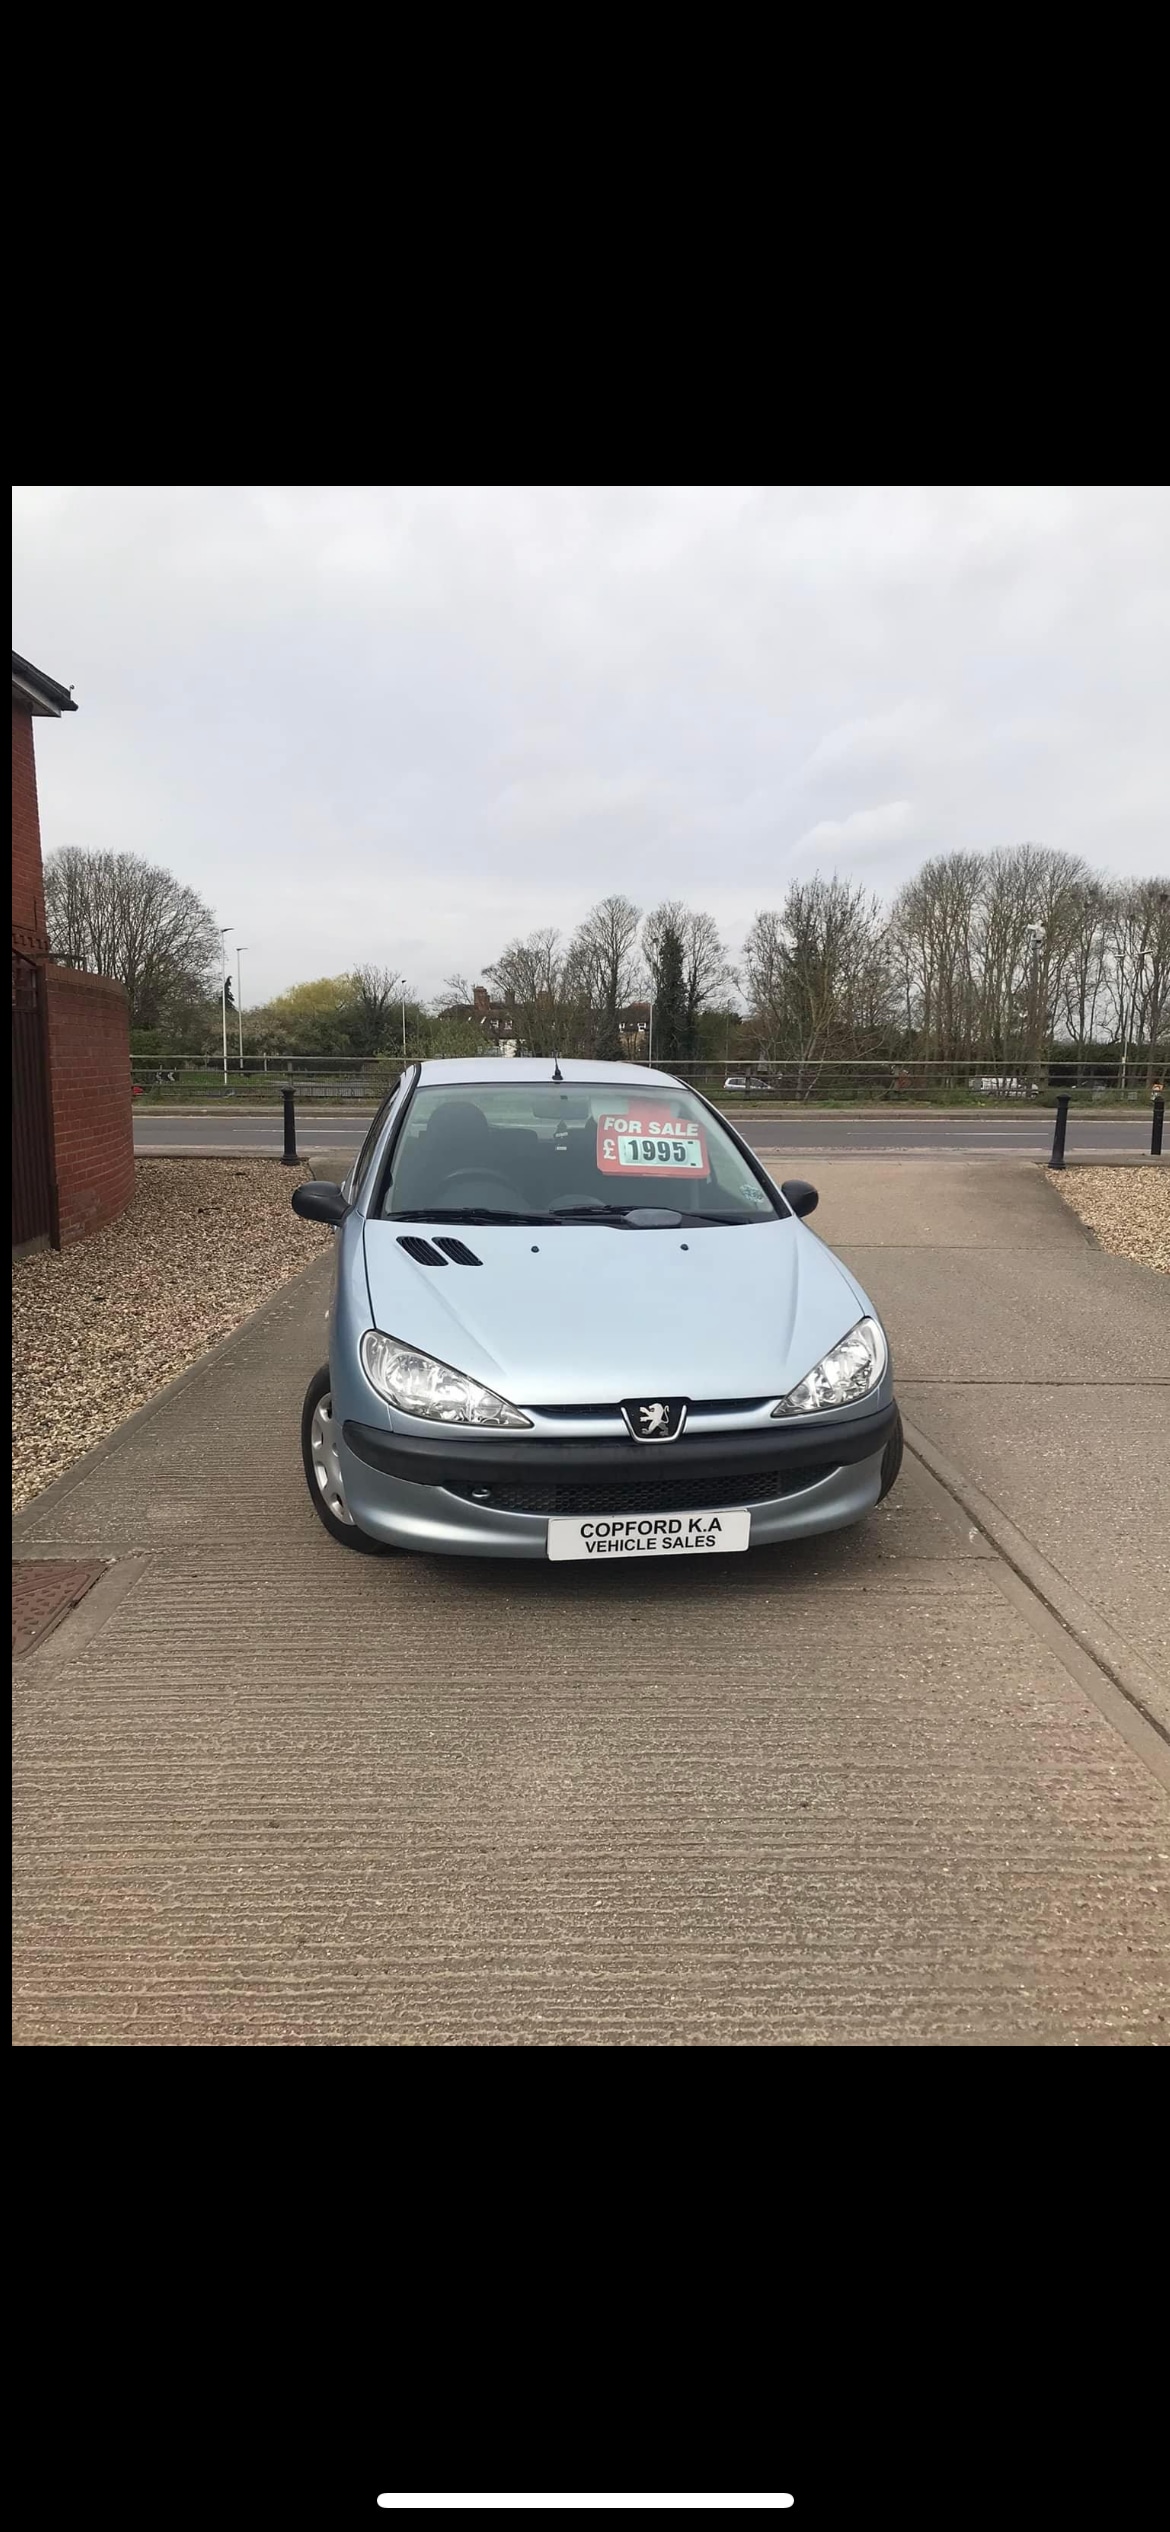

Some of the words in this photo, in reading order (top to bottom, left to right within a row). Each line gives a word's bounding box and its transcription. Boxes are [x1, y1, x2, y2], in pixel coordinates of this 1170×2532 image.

[603, 1117, 642, 1134] FOR
[648, 1121, 699, 1137] SALE
[627, 1139, 686, 1162] 1995
[580, 1519, 682, 1539] COPFORD
[688, 1517, 722, 1533] K.A
[585, 1537, 657, 1553] VEHICLE
[661, 1535, 716, 1549] SALES
